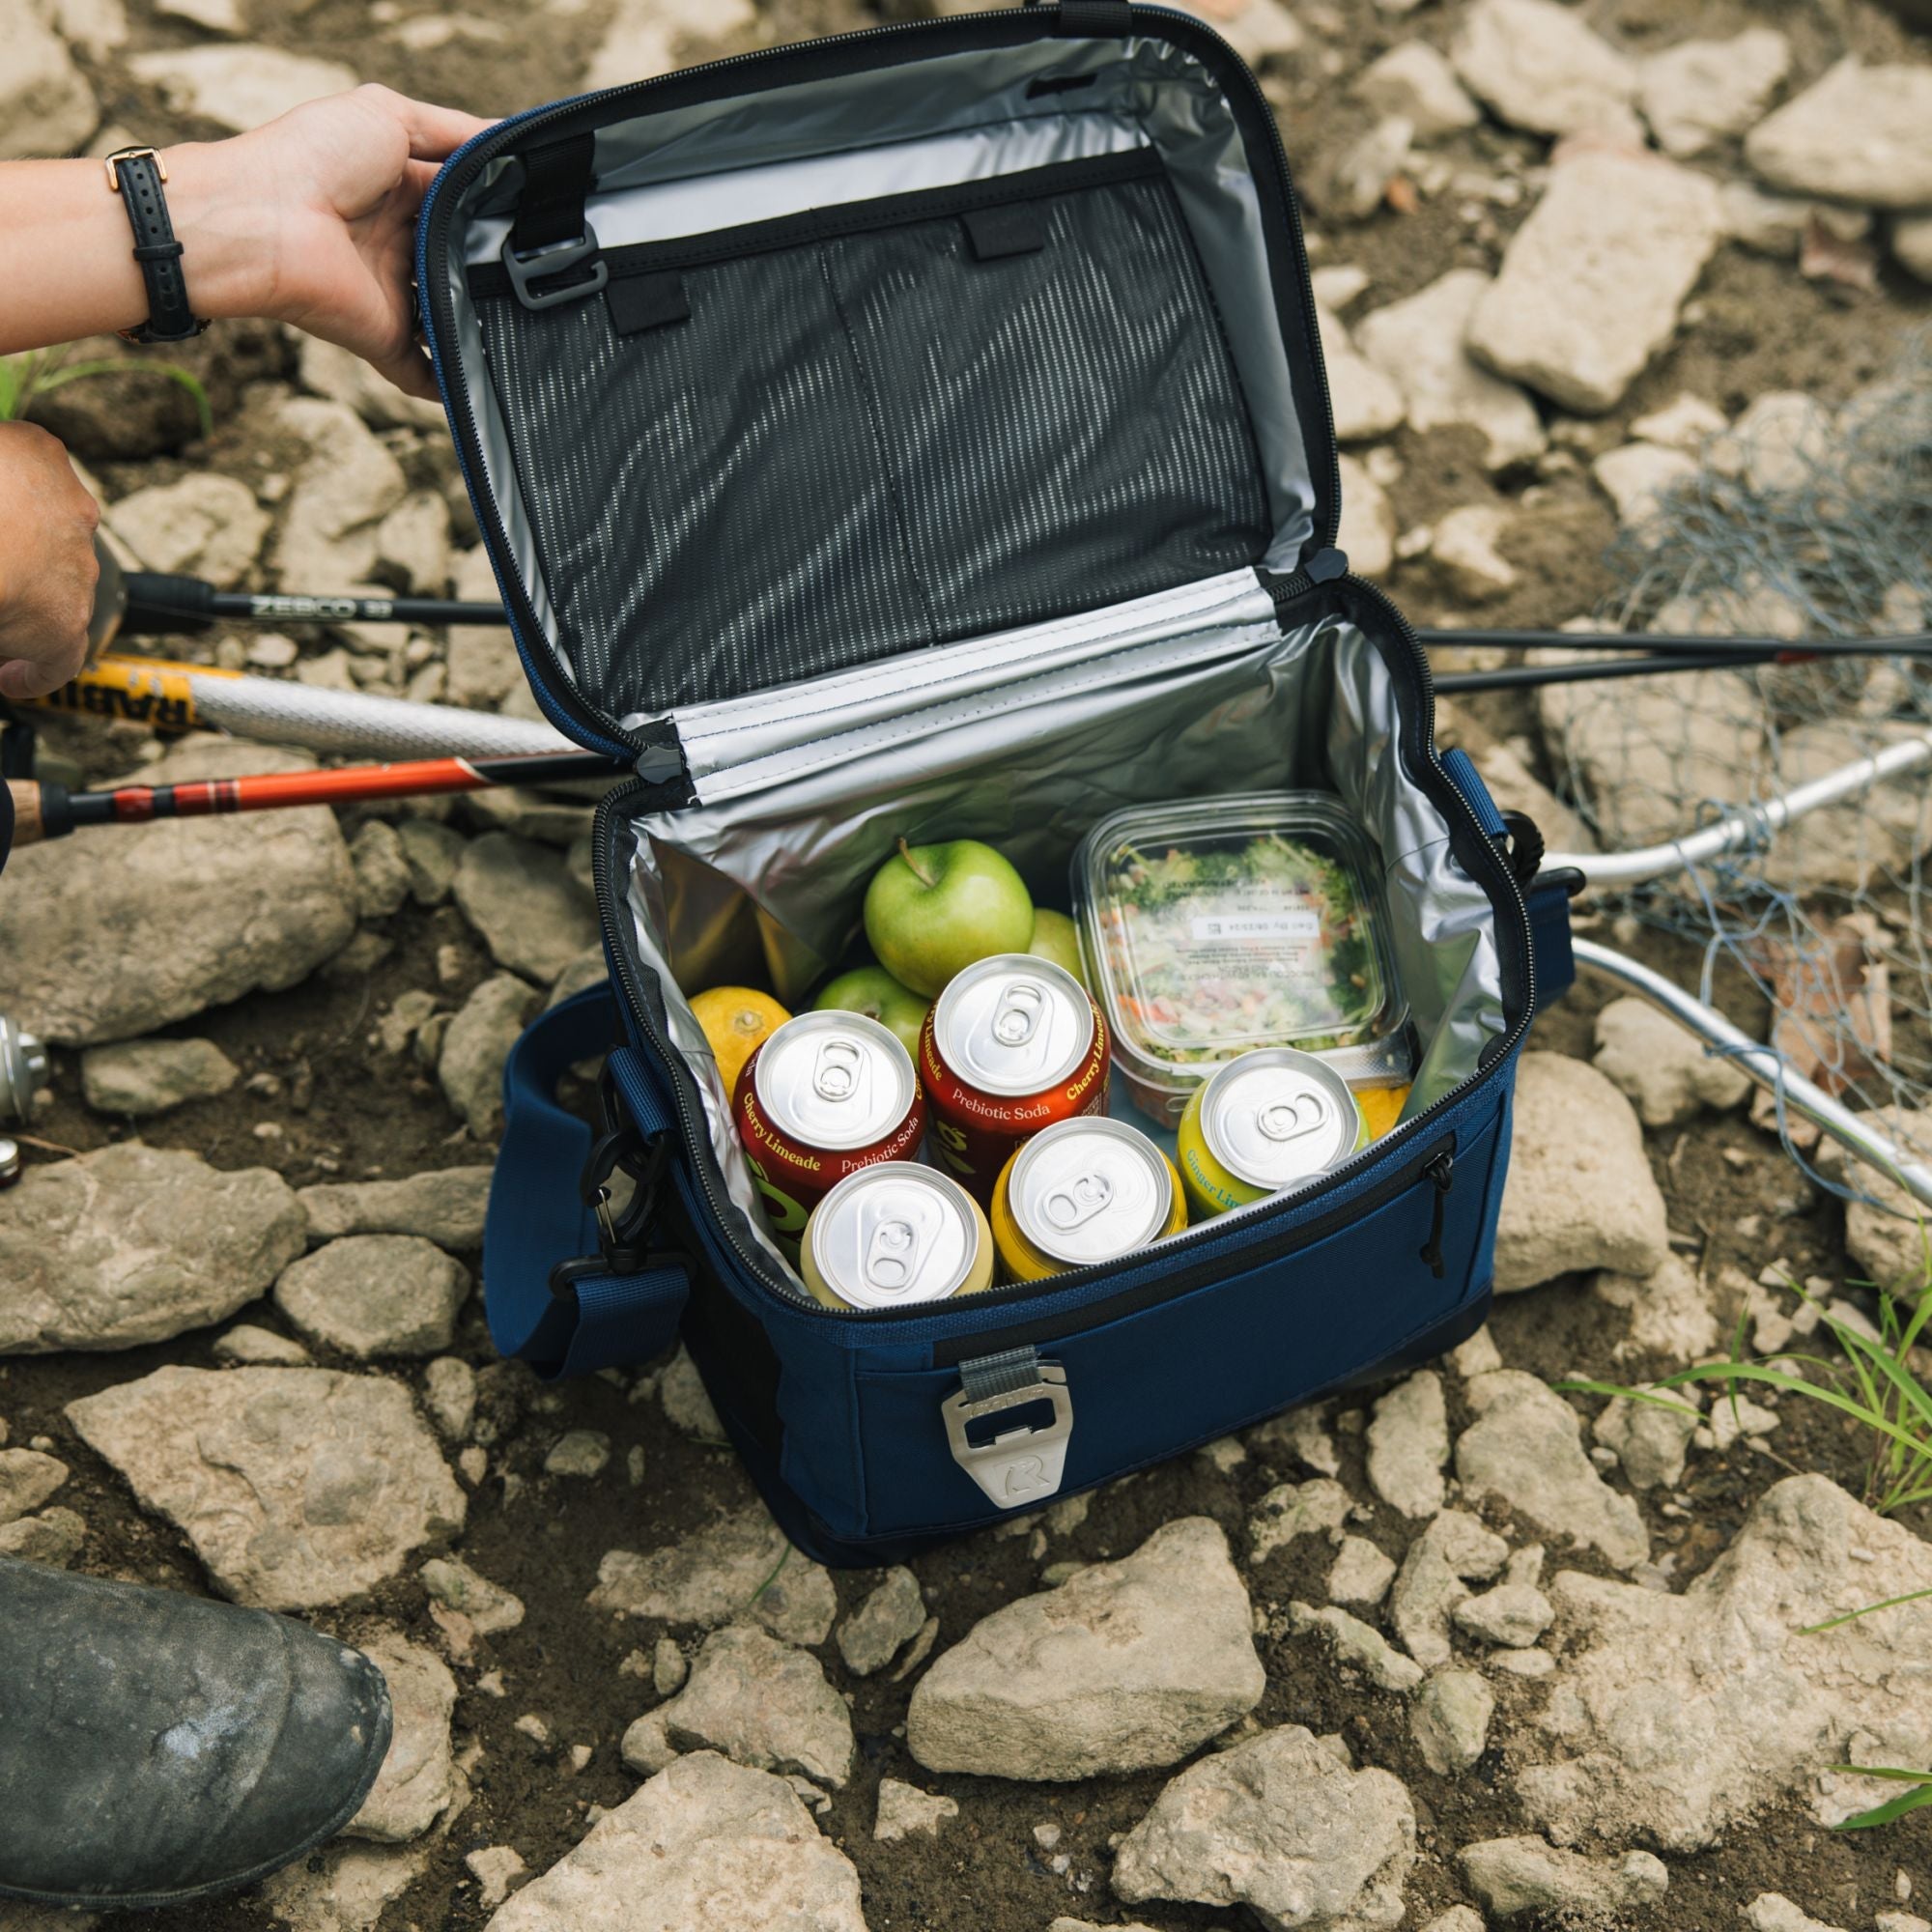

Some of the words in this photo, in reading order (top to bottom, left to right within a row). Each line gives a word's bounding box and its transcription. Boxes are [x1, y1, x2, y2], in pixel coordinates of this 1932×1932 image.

[249, 595, 357, 619] ZEBCO
[924, 1024, 943, 1082] Limeade
[1066, 1058, 1100, 1100] Cherry
[744, 1092, 767, 1139] Cherry
[764, 1133, 821, 1171] Limeade
[952, 1088, 1011, 1121] Prebiotic
[1014, 1103, 1051, 1121] Soda
[841, 1144, 898, 1173] Prebiotic
[896, 1117, 919, 1147] Soda
[1186, 1150, 1217, 1194] Ginger
[1216, 1189, 1243, 1209] Lim
